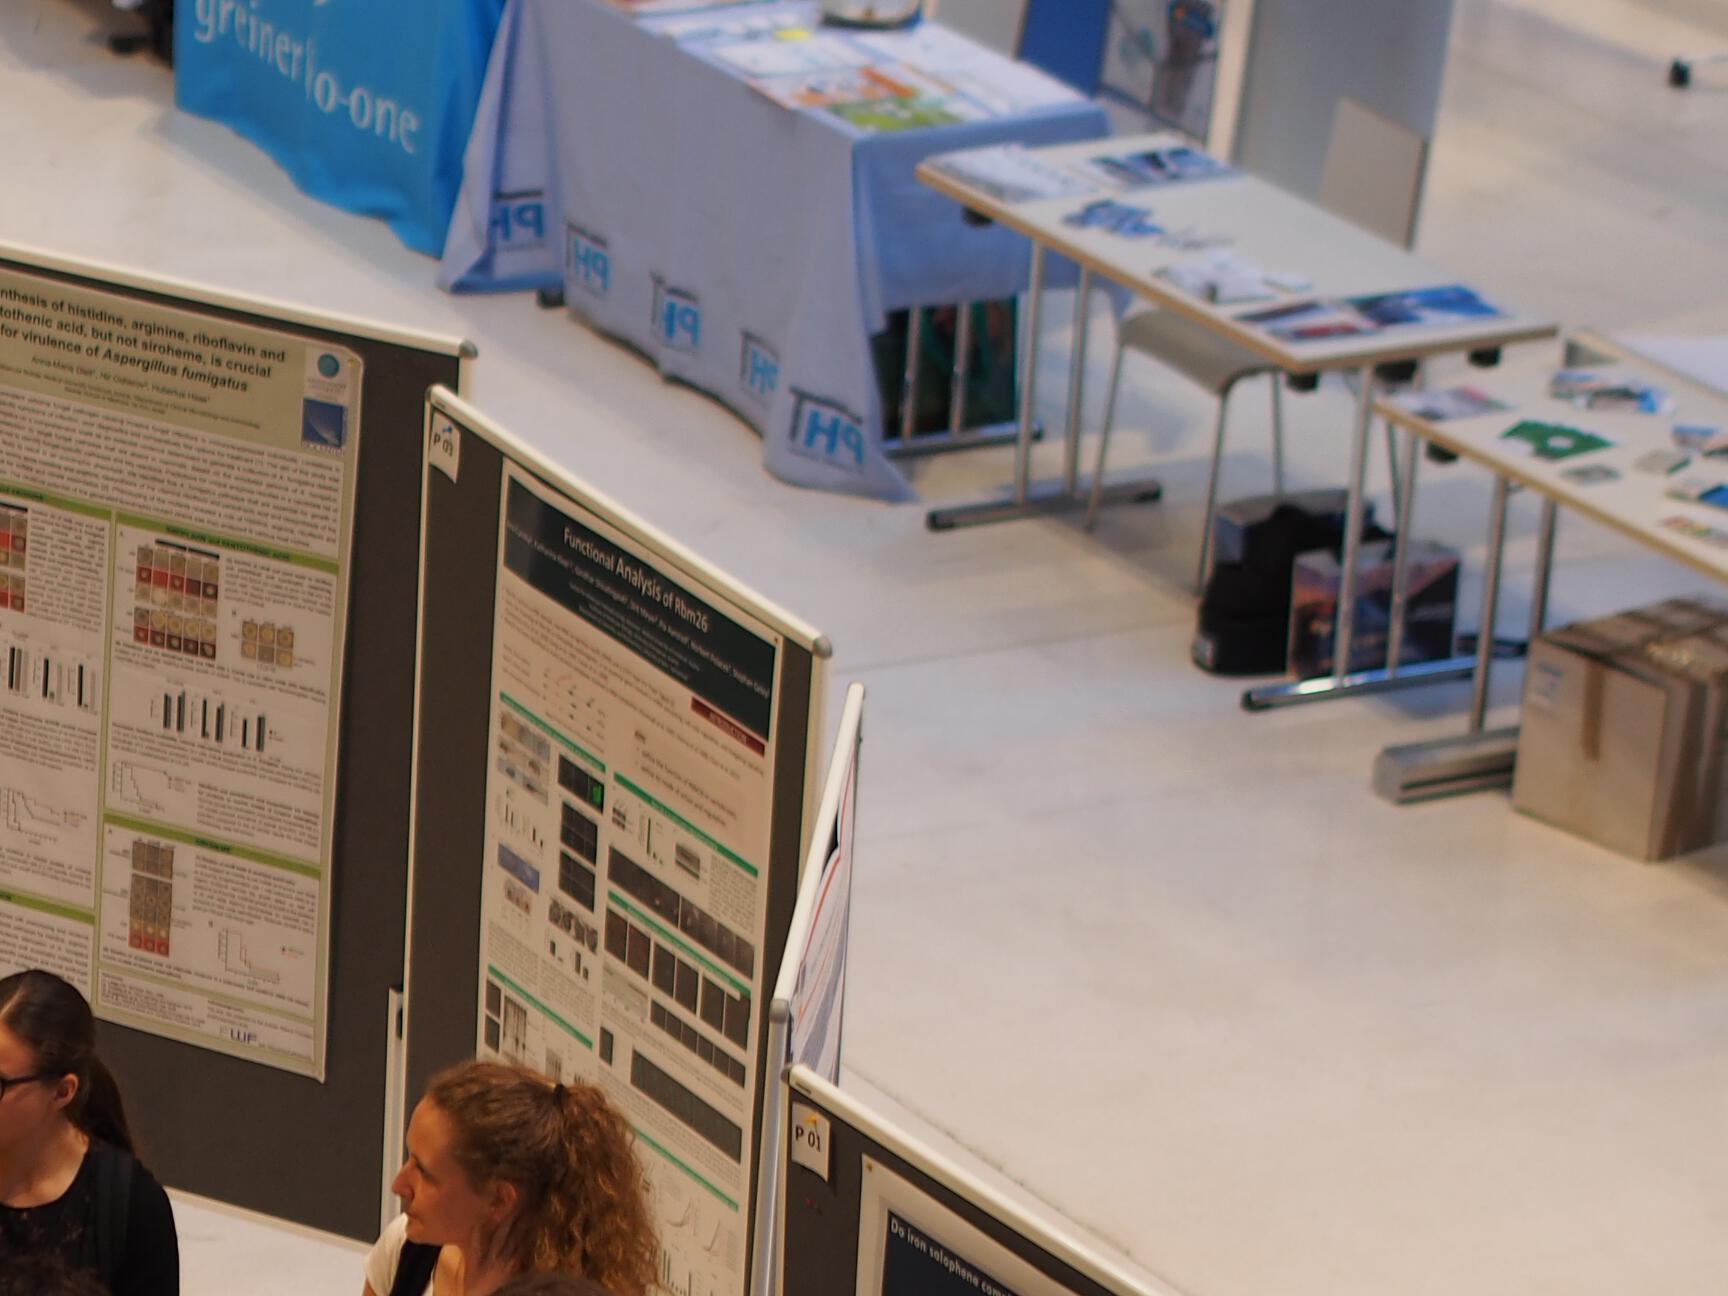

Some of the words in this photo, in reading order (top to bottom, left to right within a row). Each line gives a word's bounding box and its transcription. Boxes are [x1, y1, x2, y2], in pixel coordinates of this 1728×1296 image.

[0, 323, 19, 339] for
[21, 331, 82, 354] virulence
[85, 345, 100, 357] of
[102, 347, 178, 377] Aspergillus
[181, 365, 249, 393] fumigatus
[51, 301, 65, 313] of
[67, 303, 127, 330] histidine,
[131, 320, 189, 344] arginine,
[192, 333, 256, 357] riboflavin
[259, 349, 286, 363] and
[56, 320, 88, 339] acid,
[91, 326, 113, 343] but
[116, 334, 139, 349] not
[141, 341, 207, 366] siroheme,
[210, 354, 223, 368] is
[226, 360, 272, 379] crucial
[433, 433, 441, 446] P
[442, 438, 454, 457] 03
[563, 526, 614, 572] Functional
[615, 558, 662, 603] Analysis
[662, 592, 674, 609] of
[674, 596, 710, 634] Rbm26
[795, 1124, 804, 1141] P
[807, 1130, 821, 1153] 01
[890, 1216, 905, 1239] Do
[906, 1228, 927, 1253] iron
[928, 1244, 980, 1289] salophene
